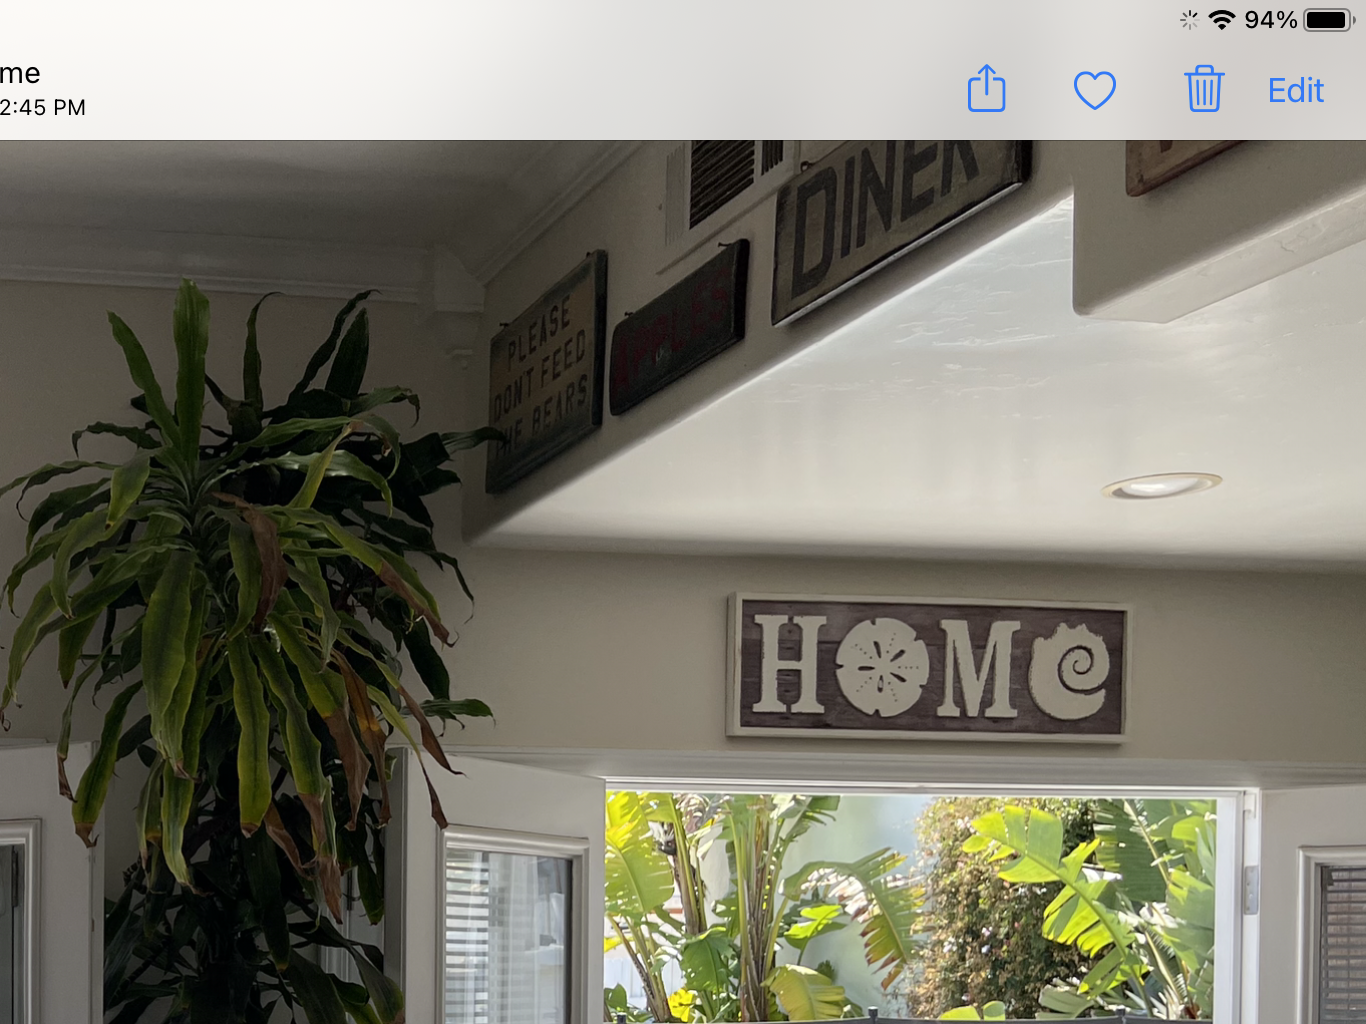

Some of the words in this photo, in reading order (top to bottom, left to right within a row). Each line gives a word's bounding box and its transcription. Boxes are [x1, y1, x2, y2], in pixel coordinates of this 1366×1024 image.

[507, 293, 571, 372] PLEASE
[540, 328, 586, 389] FEED
[531, 373, 588, 438] BEARS
